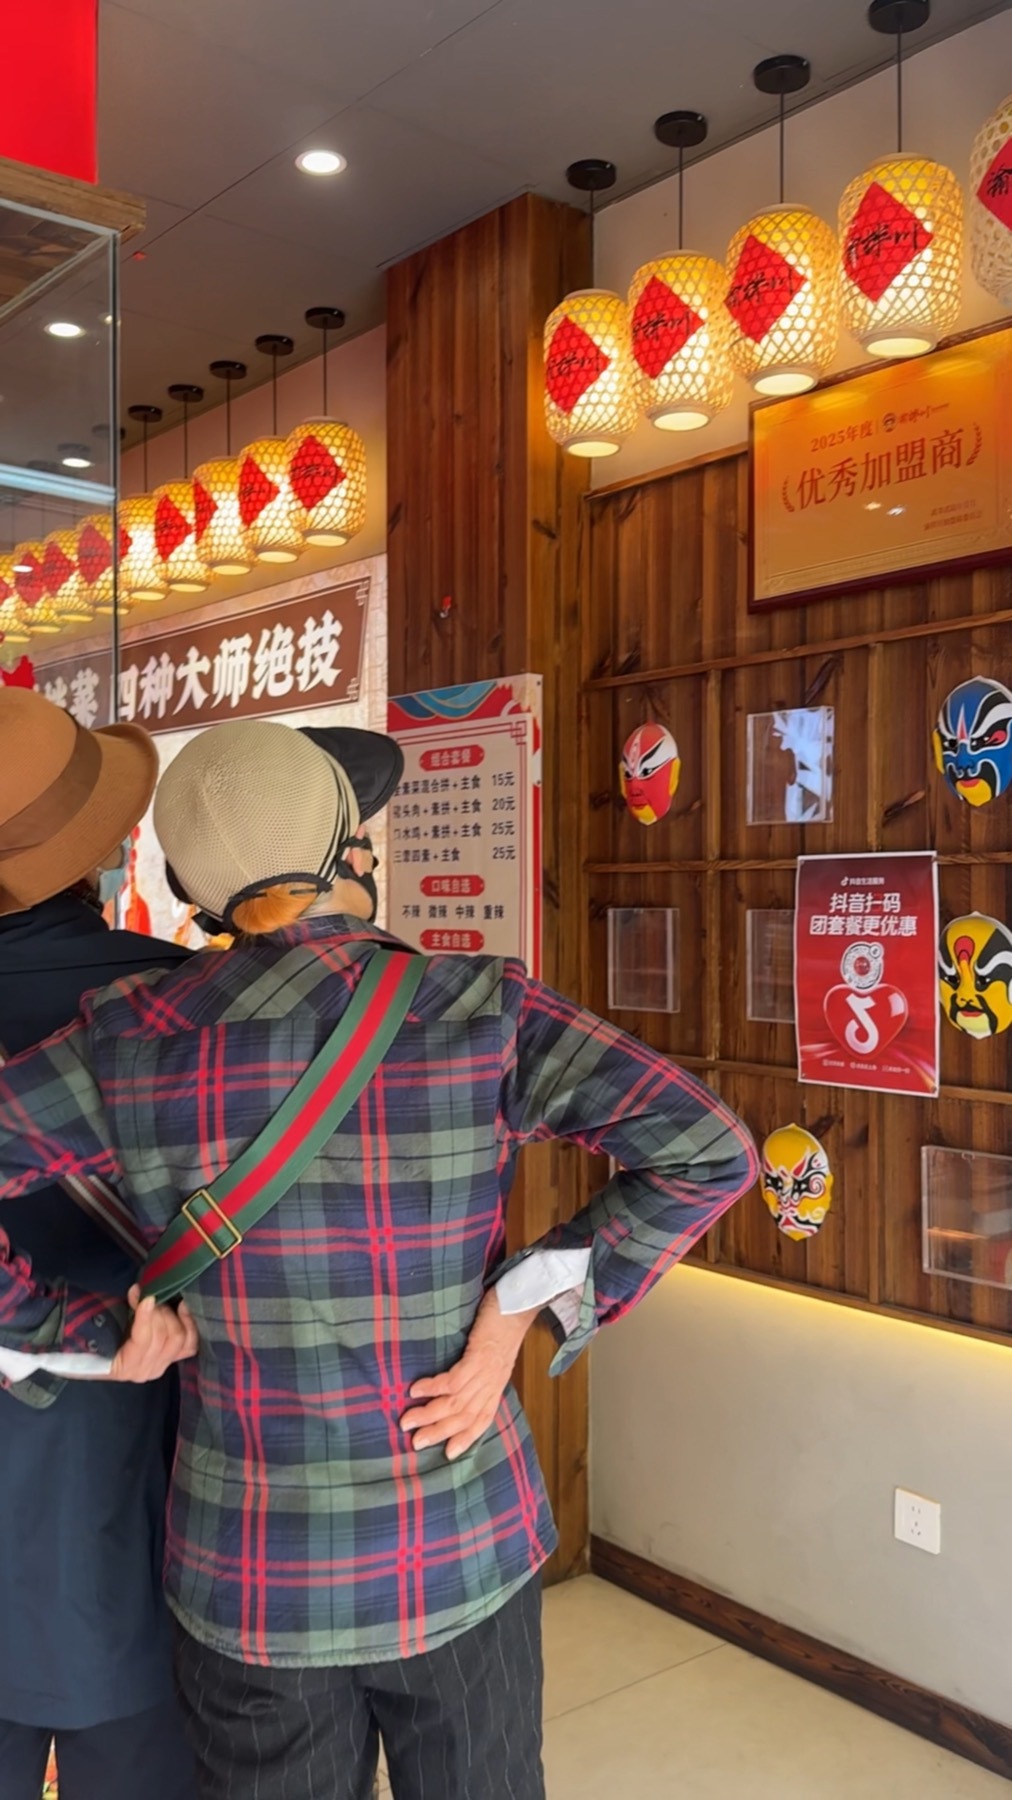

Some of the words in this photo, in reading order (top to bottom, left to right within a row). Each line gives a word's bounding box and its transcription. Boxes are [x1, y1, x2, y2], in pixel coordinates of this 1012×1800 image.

[810, 419, 873, 453] 2025年度
[796, 427, 965, 510] 优秀加盟商
[110, 609, 343, 723] 四种大师绝技
[430, 748, 471, 767] 组合套餐
[492, 772, 515, 787] 15元
[492, 796, 515, 811] 20元
[491, 821, 515, 836] 25元
[492, 845, 516, 860] 25元
[431, 879, 471, 894] 口味自选
[829, 892, 901, 914] 抖音扫码
[809, 915, 918, 937] 团套餐更优惠
[431, 932, 471, 948] 主食自选
